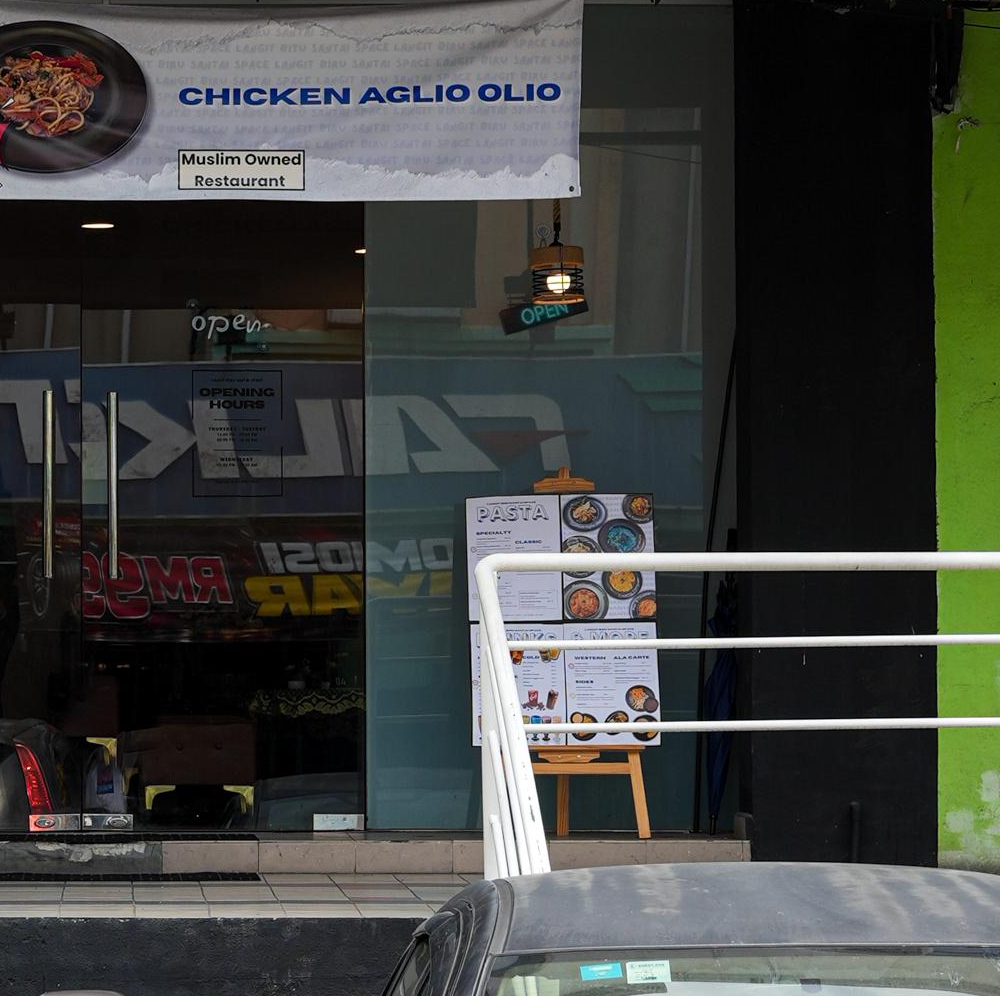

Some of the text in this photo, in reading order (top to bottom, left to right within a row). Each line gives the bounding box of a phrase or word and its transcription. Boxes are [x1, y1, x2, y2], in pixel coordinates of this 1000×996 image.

[178, 83, 562, 106] CHICKEN AGLIO OLIO
[181, 152, 302, 166] Muslim Owned
[194, 174, 286, 187] Restaurant
[521, 304, 569, 325] OPEN
[191, 313, 273, 340] open
[199, 387, 275, 397] OPENING
[209, 400, 265, 409] HOURS
[477, 504, 549, 523] PASTA
